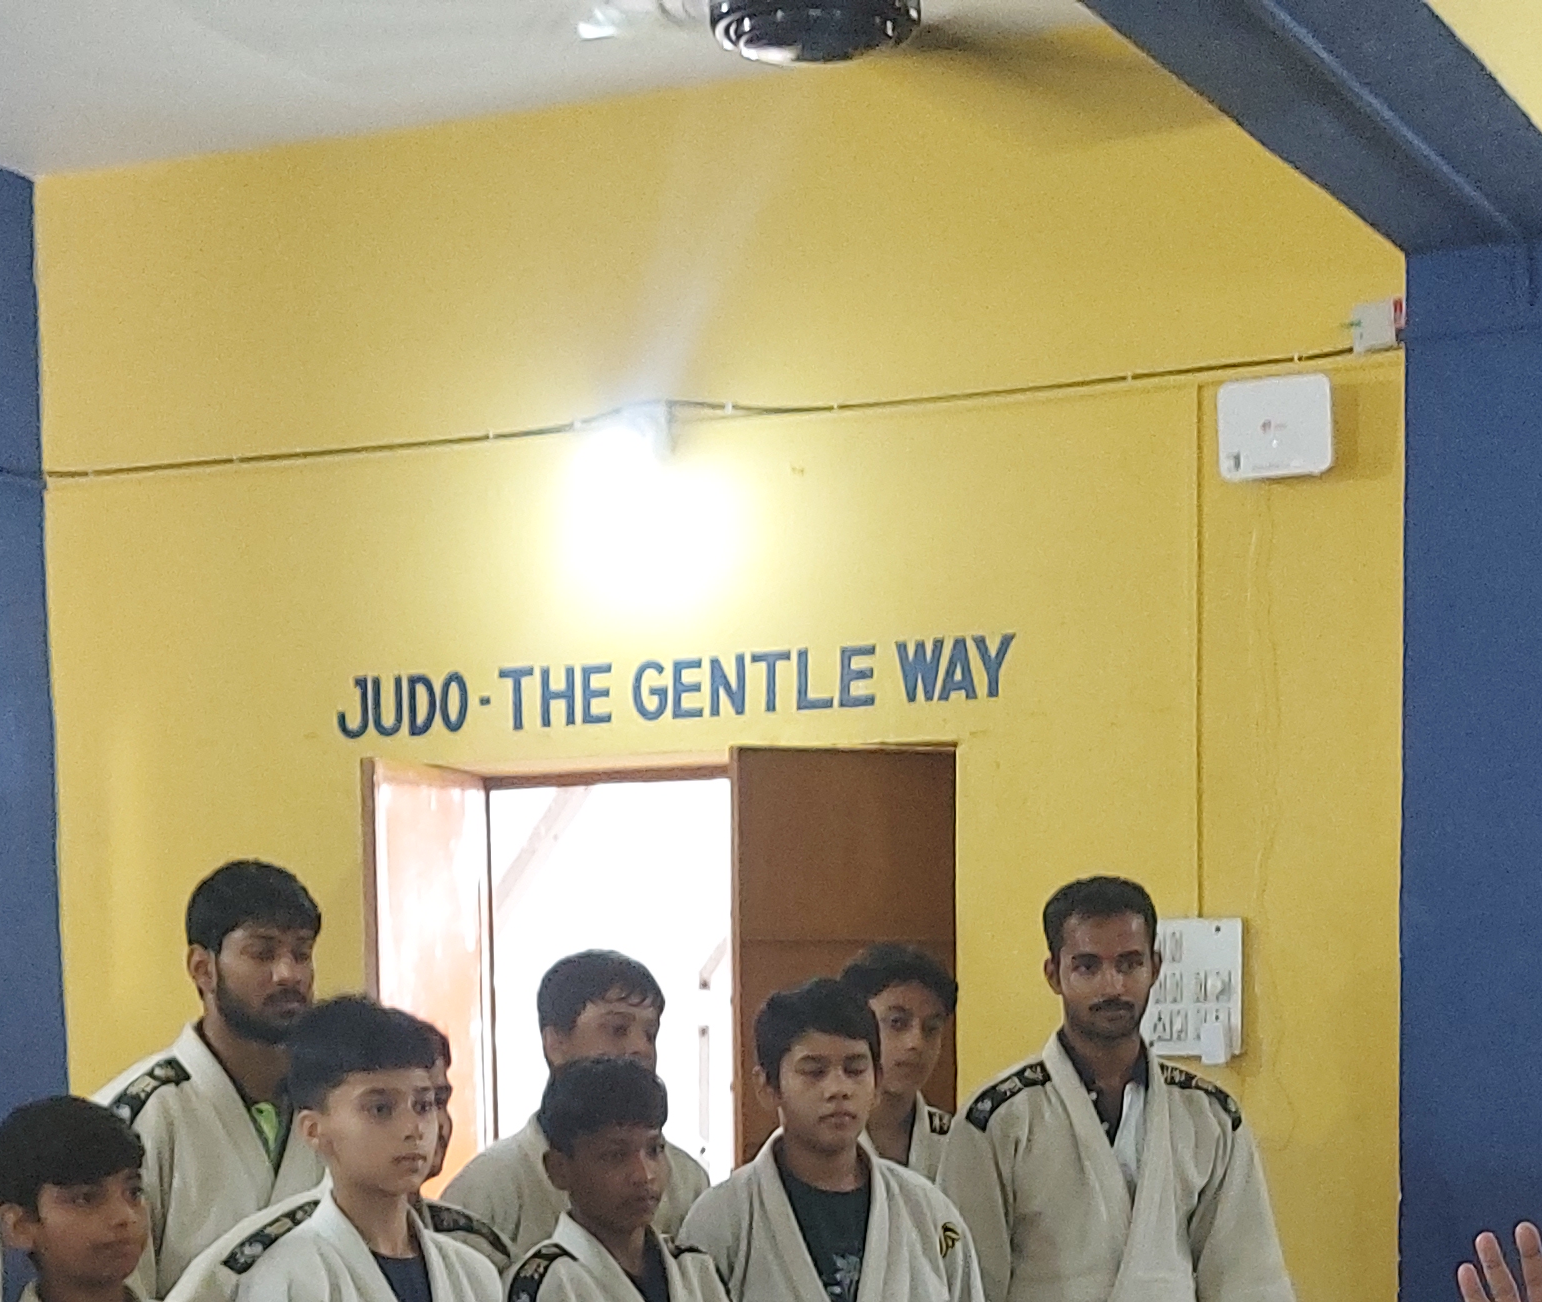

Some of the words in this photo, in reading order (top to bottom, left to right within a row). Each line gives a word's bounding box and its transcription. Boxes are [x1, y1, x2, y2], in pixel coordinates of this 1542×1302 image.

[336, 671, 470, 740] JUDO
[498, 662, 613, 731] THE
[631, 643, 878, 722] GENTLE
[895, 631, 1017, 703] WAY
